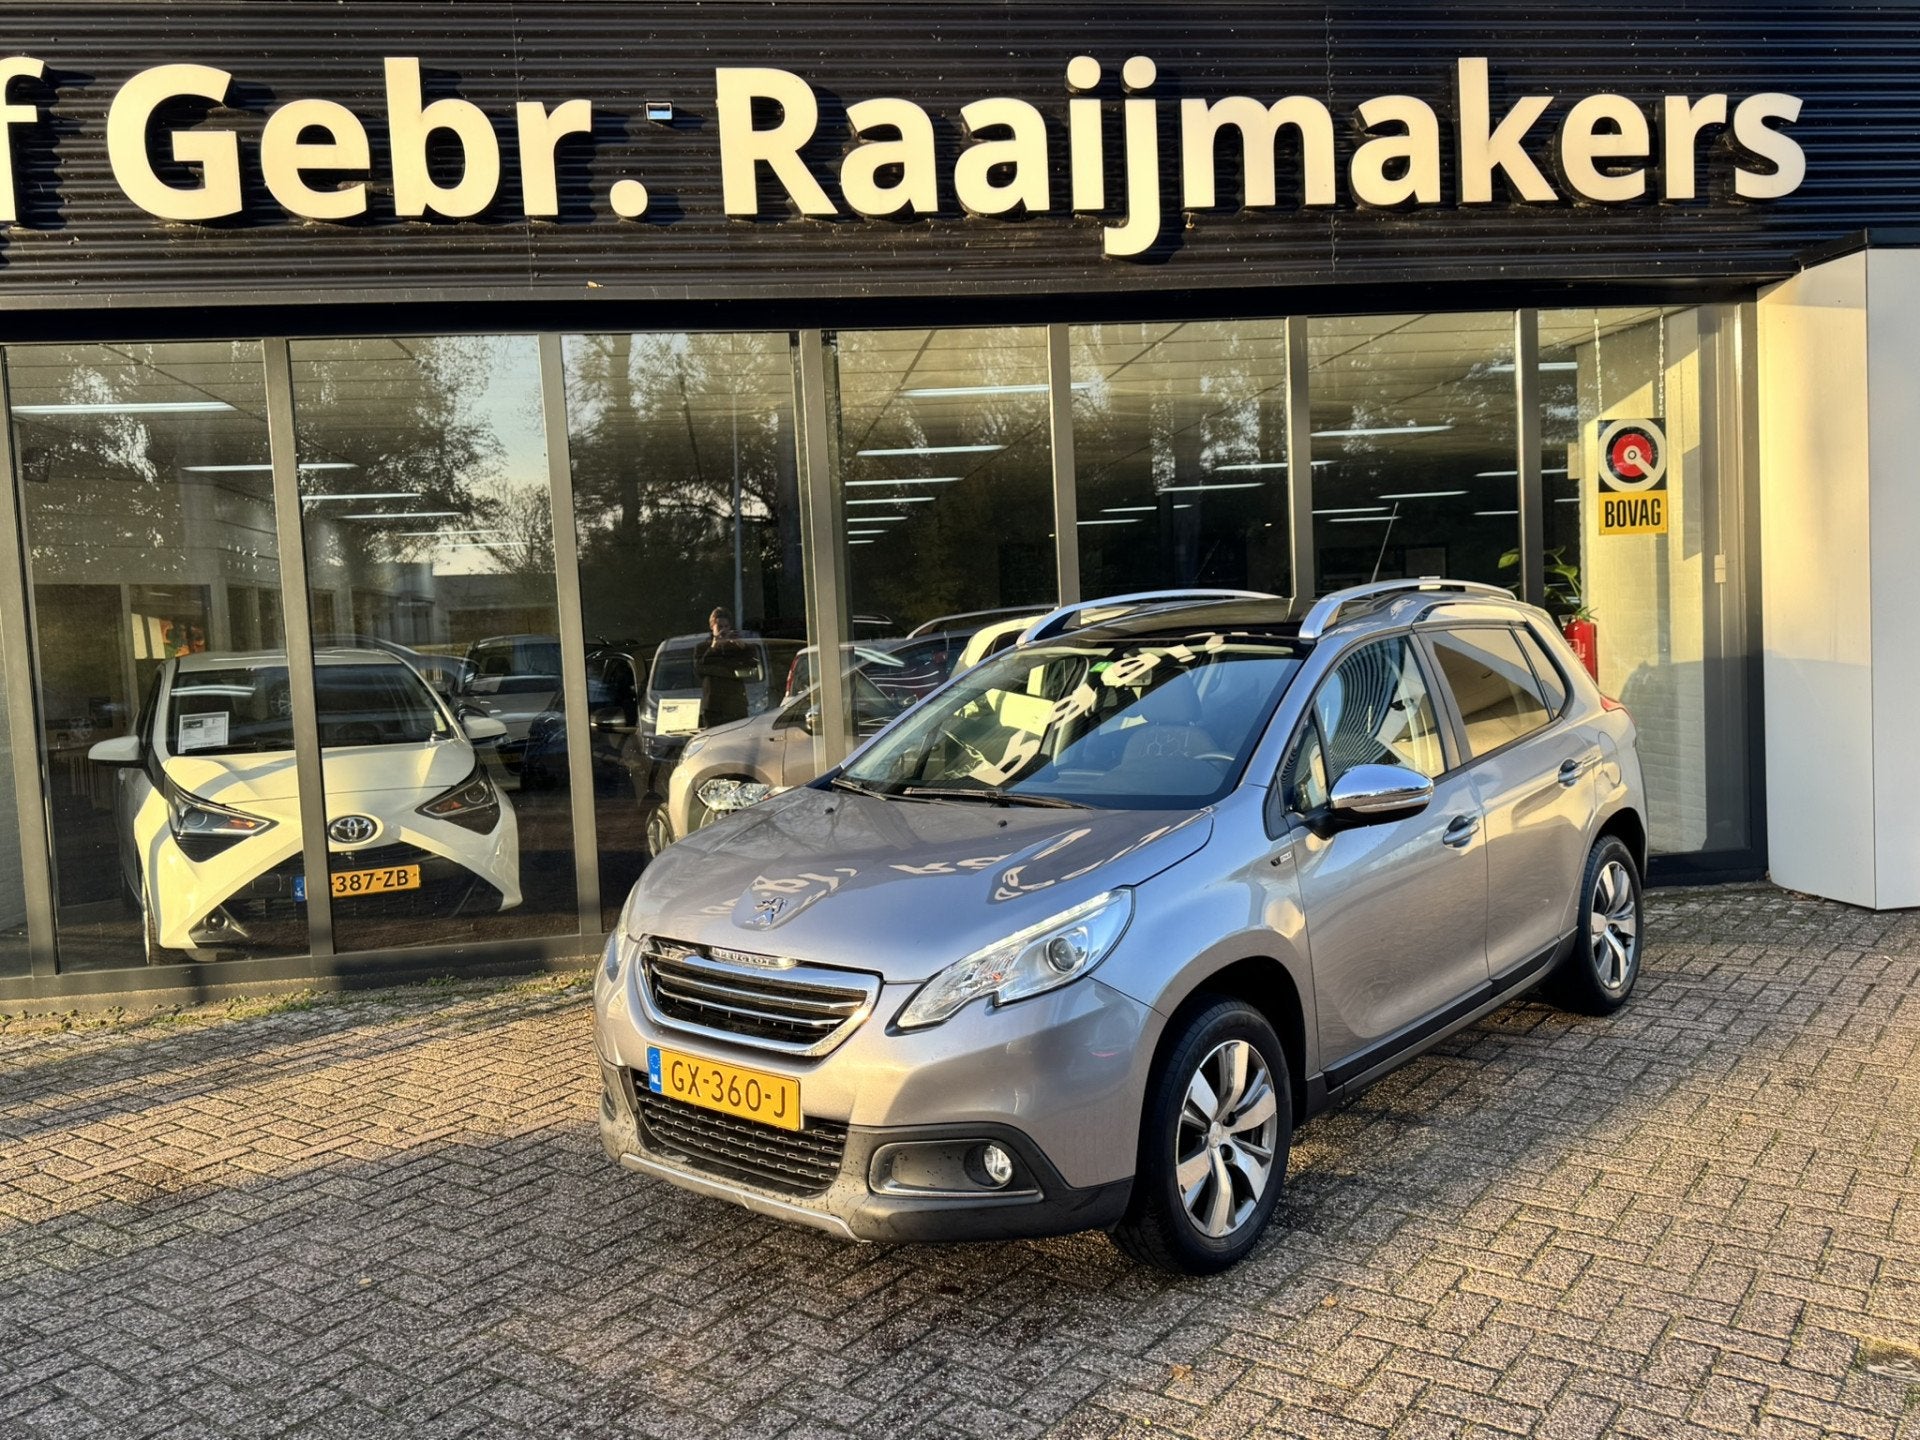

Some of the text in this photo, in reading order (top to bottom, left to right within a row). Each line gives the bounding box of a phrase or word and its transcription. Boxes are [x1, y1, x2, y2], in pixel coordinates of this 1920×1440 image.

[106, 57, 649, 220] Gebr.
[715, 55, 1807, 258] Raaijmakers
[1604, 498, 1661, 527] BOVAG
[331, 869, 409, 893] -387-ZB
[650, 1073, 661, 1085] NL
[670, 1060, 786, 1119] GX-360-J
